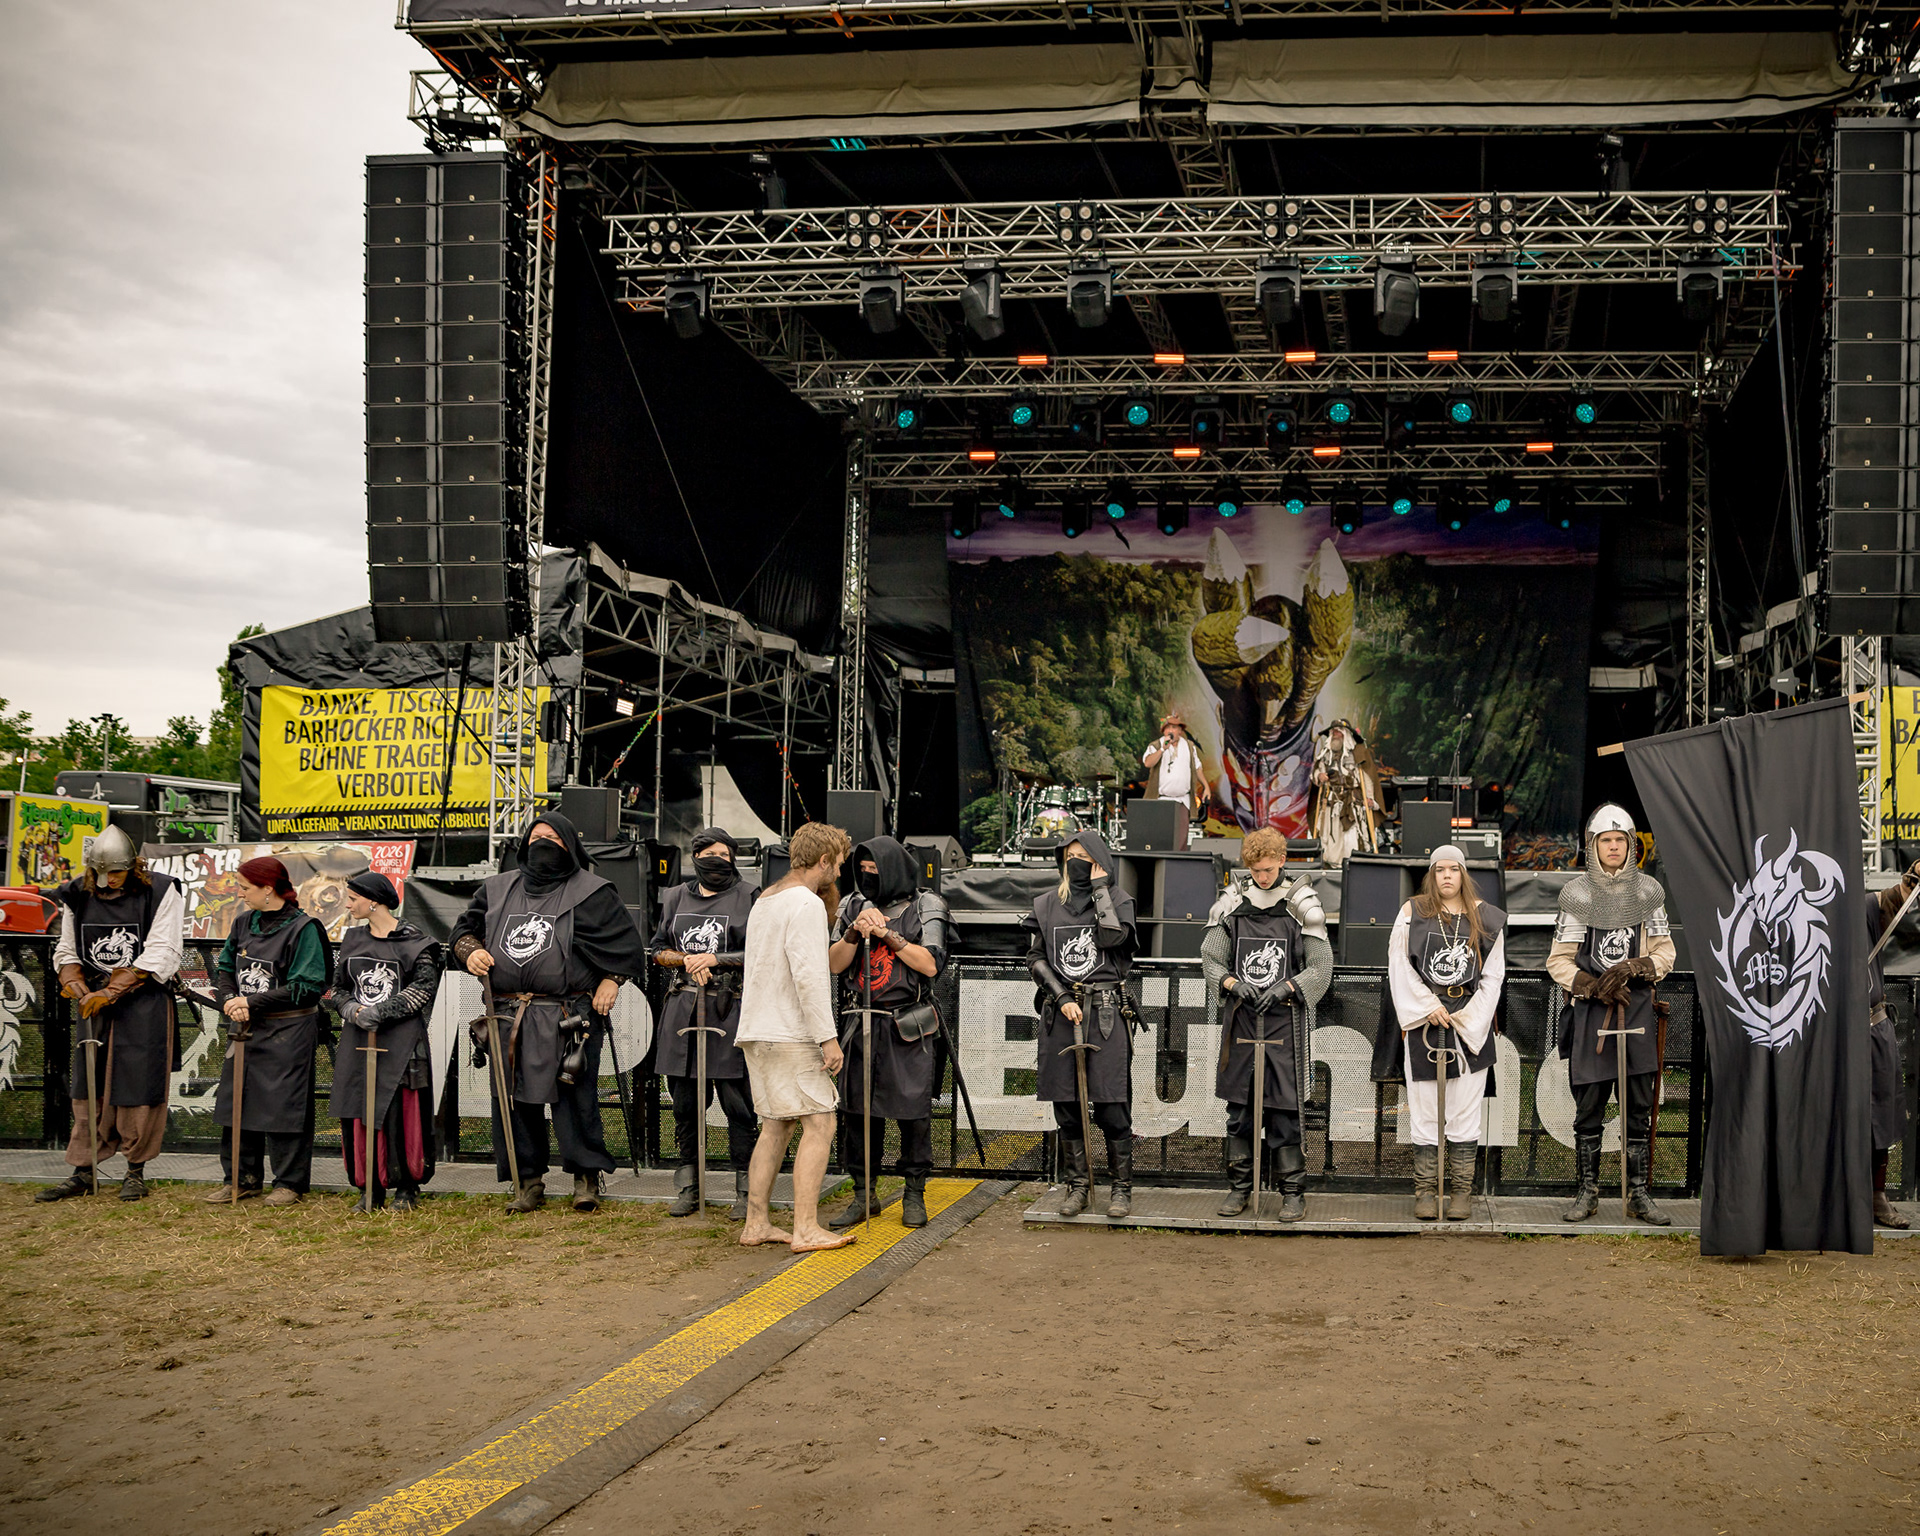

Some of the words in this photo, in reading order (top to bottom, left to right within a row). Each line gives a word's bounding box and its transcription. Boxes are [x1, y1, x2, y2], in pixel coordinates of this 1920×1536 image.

[300, 692, 377, 716] BÄNKE,
[387, 690, 457, 713] TISCHE
[462, 690, 505, 710] UN
[284, 716, 406, 744] BARHOCKER
[412, 713, 503, 740] RICHTUN
[300, 743, 367, 771] BÜHNE
[374, 742, 457, 769] TRAGEN
[464, 741, 492, 766] IST
[337, 770, 453, 798] VERBOTEN!
[374, 845, 403, 859] 2026
[96, 952, 121, 961] MPS
[686, 942, 708, 951] MPS
[1603, 946, 1624, 956] MPS
[1247, 965, 1268, 975] MPS
[1742, 951, 1788, 992] MS
